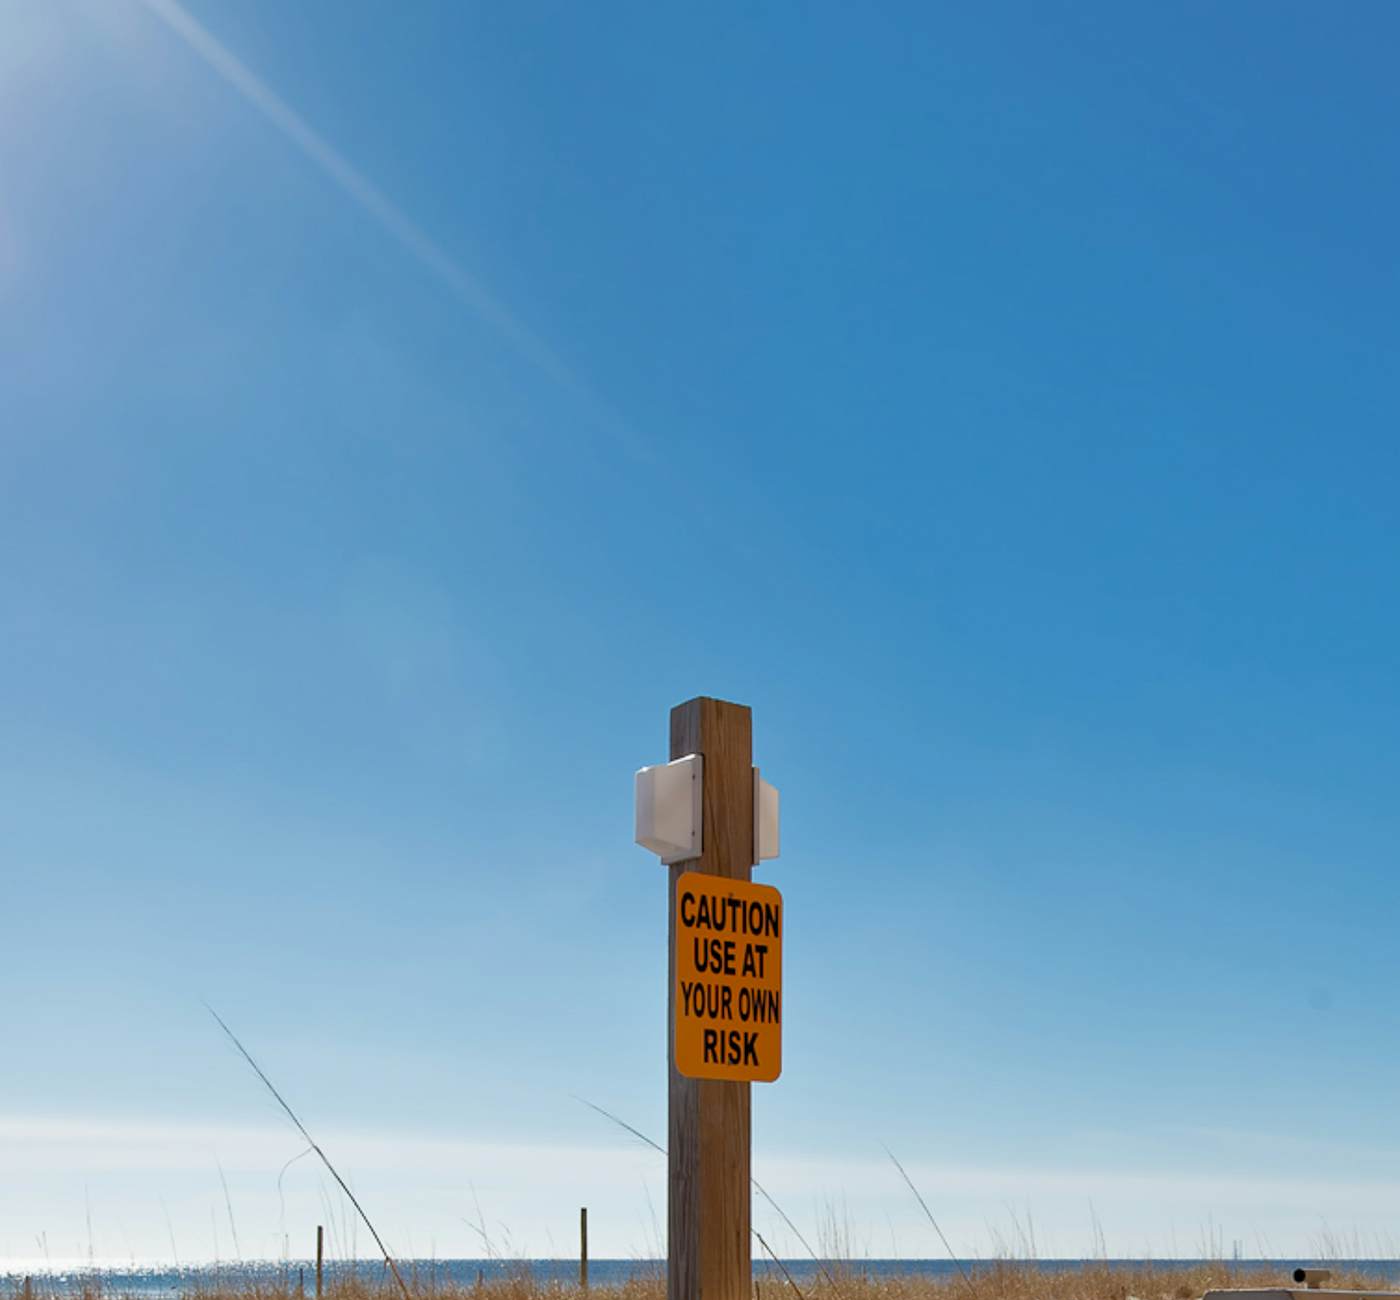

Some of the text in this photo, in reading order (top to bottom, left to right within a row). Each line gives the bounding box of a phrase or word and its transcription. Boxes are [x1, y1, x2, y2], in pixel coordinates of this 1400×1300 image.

[681, 891, 779, 938] CAUTION
[694, 937, 768, 979] USE AT
[680, 981, 779, 1024] YOUR OWN
[703, 1029, 760, 1066] RISK
